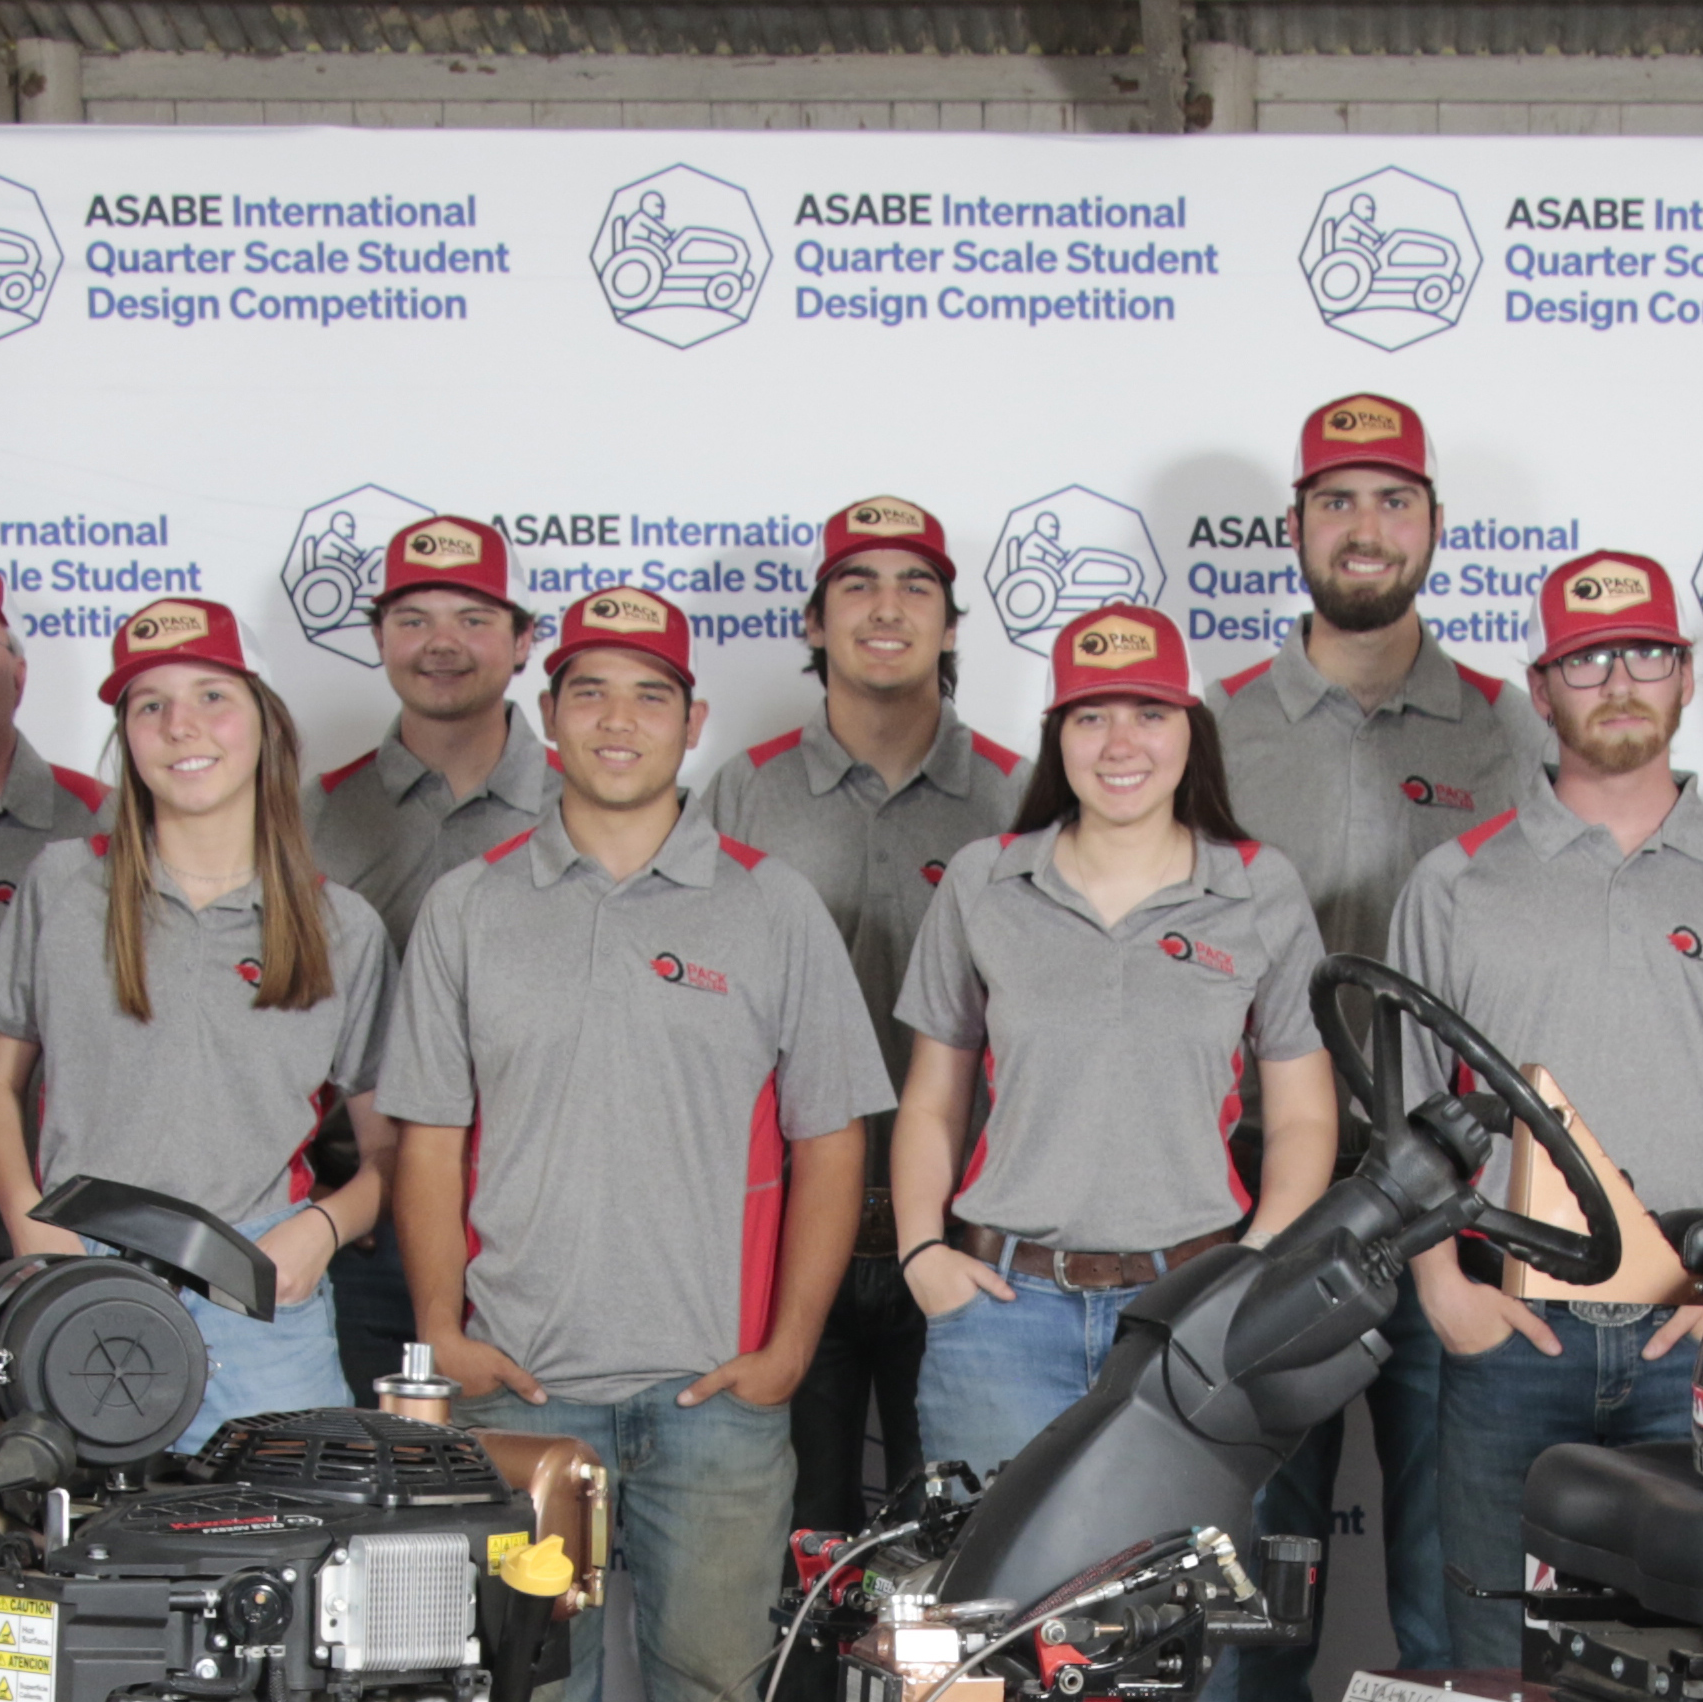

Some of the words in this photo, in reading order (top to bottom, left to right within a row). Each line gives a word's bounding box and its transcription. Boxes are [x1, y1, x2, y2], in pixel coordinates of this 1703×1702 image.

[85, 194, 222, 227] ASABE
[233, 195, 475, 227] International
[795, 193, 932, 226] ASABE
[943, 194, 1185, 228] International
[1506, 197, 1644, 230] ASABE
[86, 241, 235, 278] Quarter
[244, 241, 349, 274] Scale
[358, 241, 510, 274] Student
[795, 240, 944, 277] Quarter
[953, 240, 1058, 273] Scale
[1067, 241, 1218, 274] Student
[1505, 244, 1656, 281] Quarter
[88, 287, 220, 327] Design
[229, 287, 466, 327] Competition
[796, 286, 927, 327] Design
[937, 286, 1174, 327] Competition
[1506, 290, 1638, 331] Design
[631, 514, 824, 547] Internatio
[1448, 520, 1579, 550] ational
[51, 559, 202, 592] Student
[641, 560, 745, 592] Scale
[1602, 578, 1640, 590] PACK
[158, 616, 197, 628] PACK
[620, 602, 658, 617] PACK
[1109, 633, 1147, 647] PACK
[1189, 609, 1296, 647] Desig
[10, 1599, 52, 1614] CAUTION
[7, 1655, 49, 1671] ATENCION
